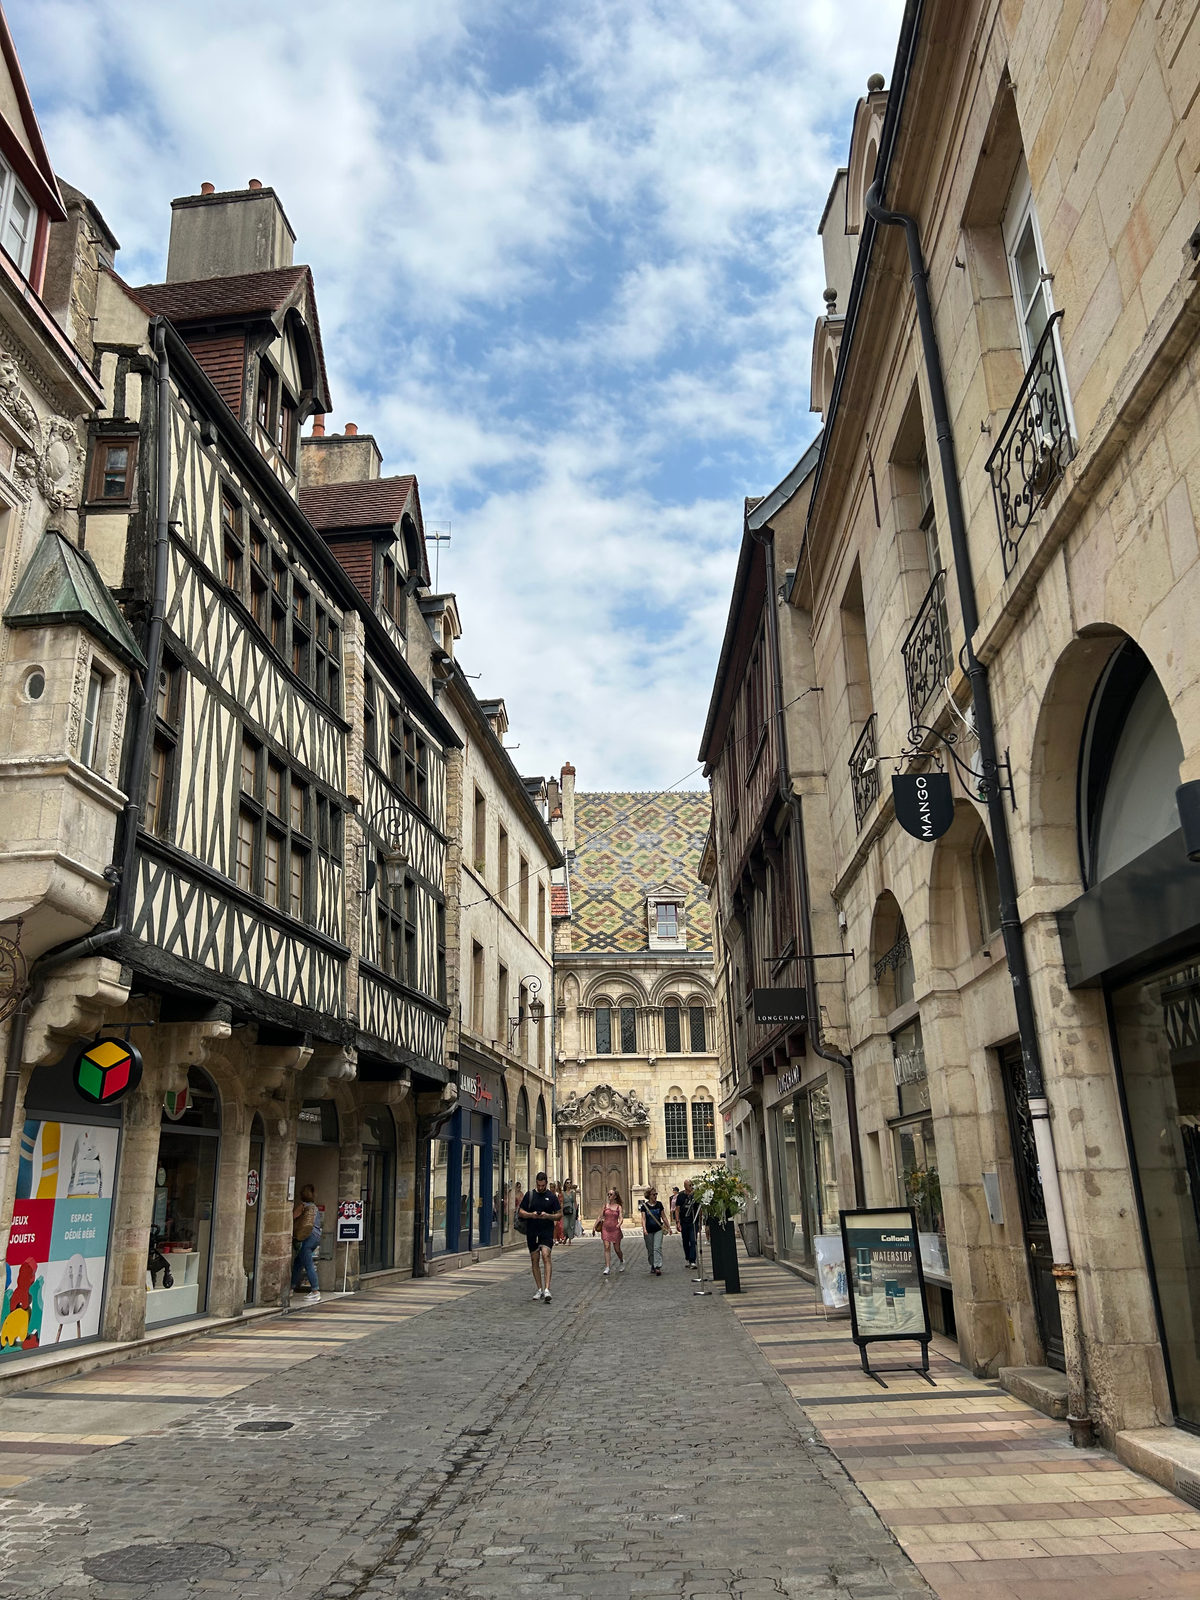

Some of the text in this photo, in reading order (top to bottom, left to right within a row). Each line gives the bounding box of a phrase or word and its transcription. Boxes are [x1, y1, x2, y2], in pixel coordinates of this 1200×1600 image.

[916, 777, 933, 837] MANGO
[460, 1074, 477, 1095] JAMES
[11, 1215, 29, 1226] JEUX
[70, 1213, 93, 1223] ESPACE
[9, 1233, 36, 1244] JOUETS
[64, 1227, 97, 1240] DÉDIÉ BÉBÉ
[881, 1234, 910, 1242] Collonil
[872, 1251, 913, 1262] WATERSTOP
